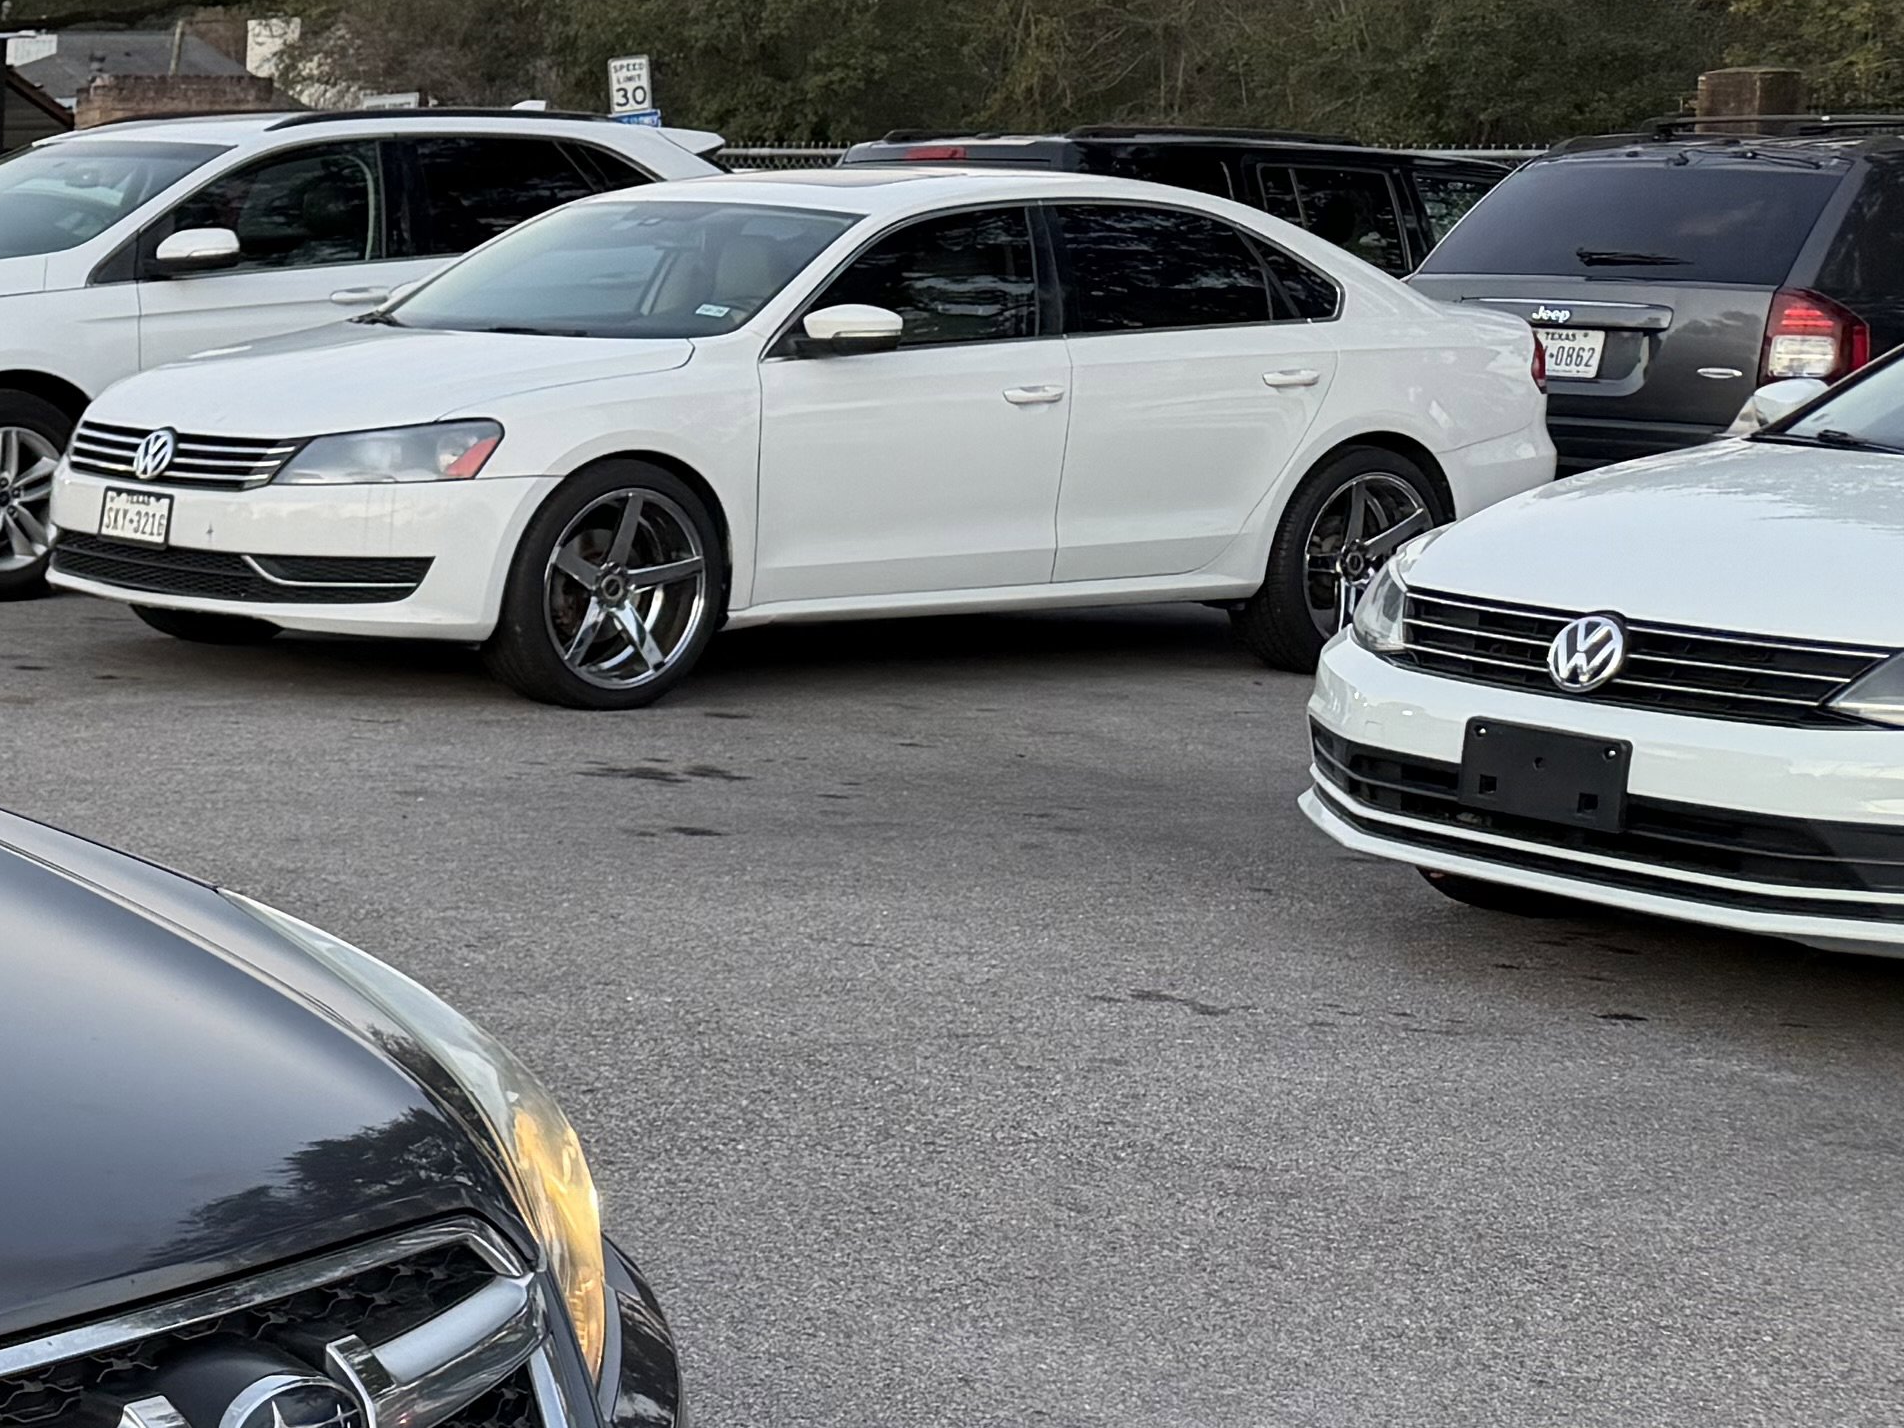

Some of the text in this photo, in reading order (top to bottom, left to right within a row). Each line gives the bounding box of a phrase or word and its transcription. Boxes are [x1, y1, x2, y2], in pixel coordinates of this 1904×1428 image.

[612, 62, 645, 73] SPEED
[617, 74, 642, 85] LIMIT
[615, 85, 647, 107] 30
[1532, 305, 1571, 323] Jeep
[1545, 332, 1577, 342] TEXAS
